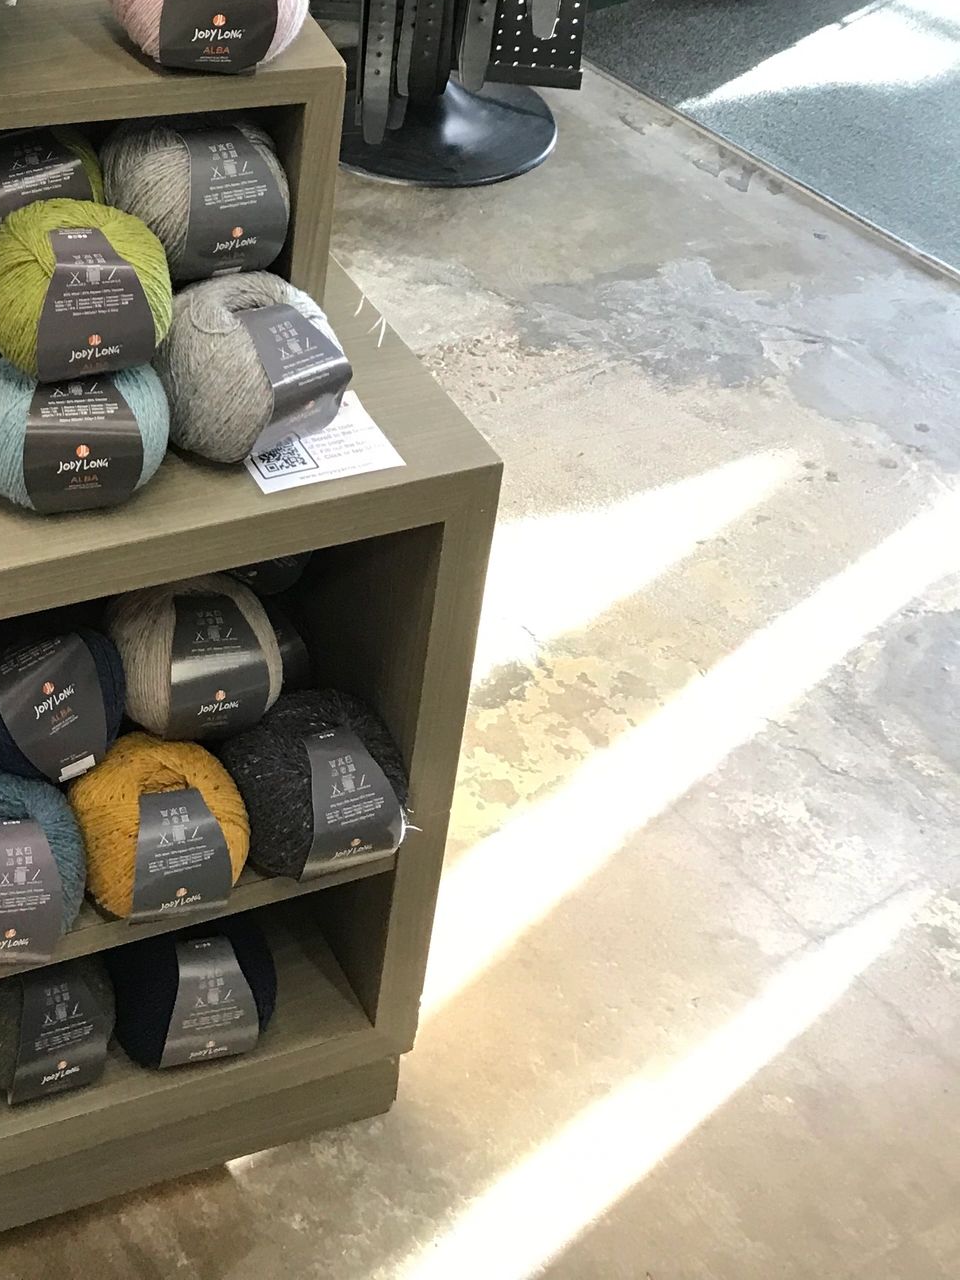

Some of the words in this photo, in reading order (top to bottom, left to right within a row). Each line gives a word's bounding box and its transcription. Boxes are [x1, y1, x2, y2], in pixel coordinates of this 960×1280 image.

[192, 28, 218, 42] JODY
[218, 28, 242, 40] LONG
[203, 46, 230, 54] ALBA
[213, 242, 236, 254] JODY
[236, 237, 257, 248] LONG
[69, 347, 94, 363] JODY
[94, 346, 120, 358] LONG
[57, 460, 82, 474] JODY
[84, 458, 108, 470] LONG
[34, 697, 54, 720] JODY
[54, 685, 74, 706] LONG
[198, 703, 218, 716] JODY
[219, 700, 239, 712] LONG
[158, 898, 180, 912] JODY
[180, 894, 202, 906] LONG
[7, 938, 29, 948] LONG
